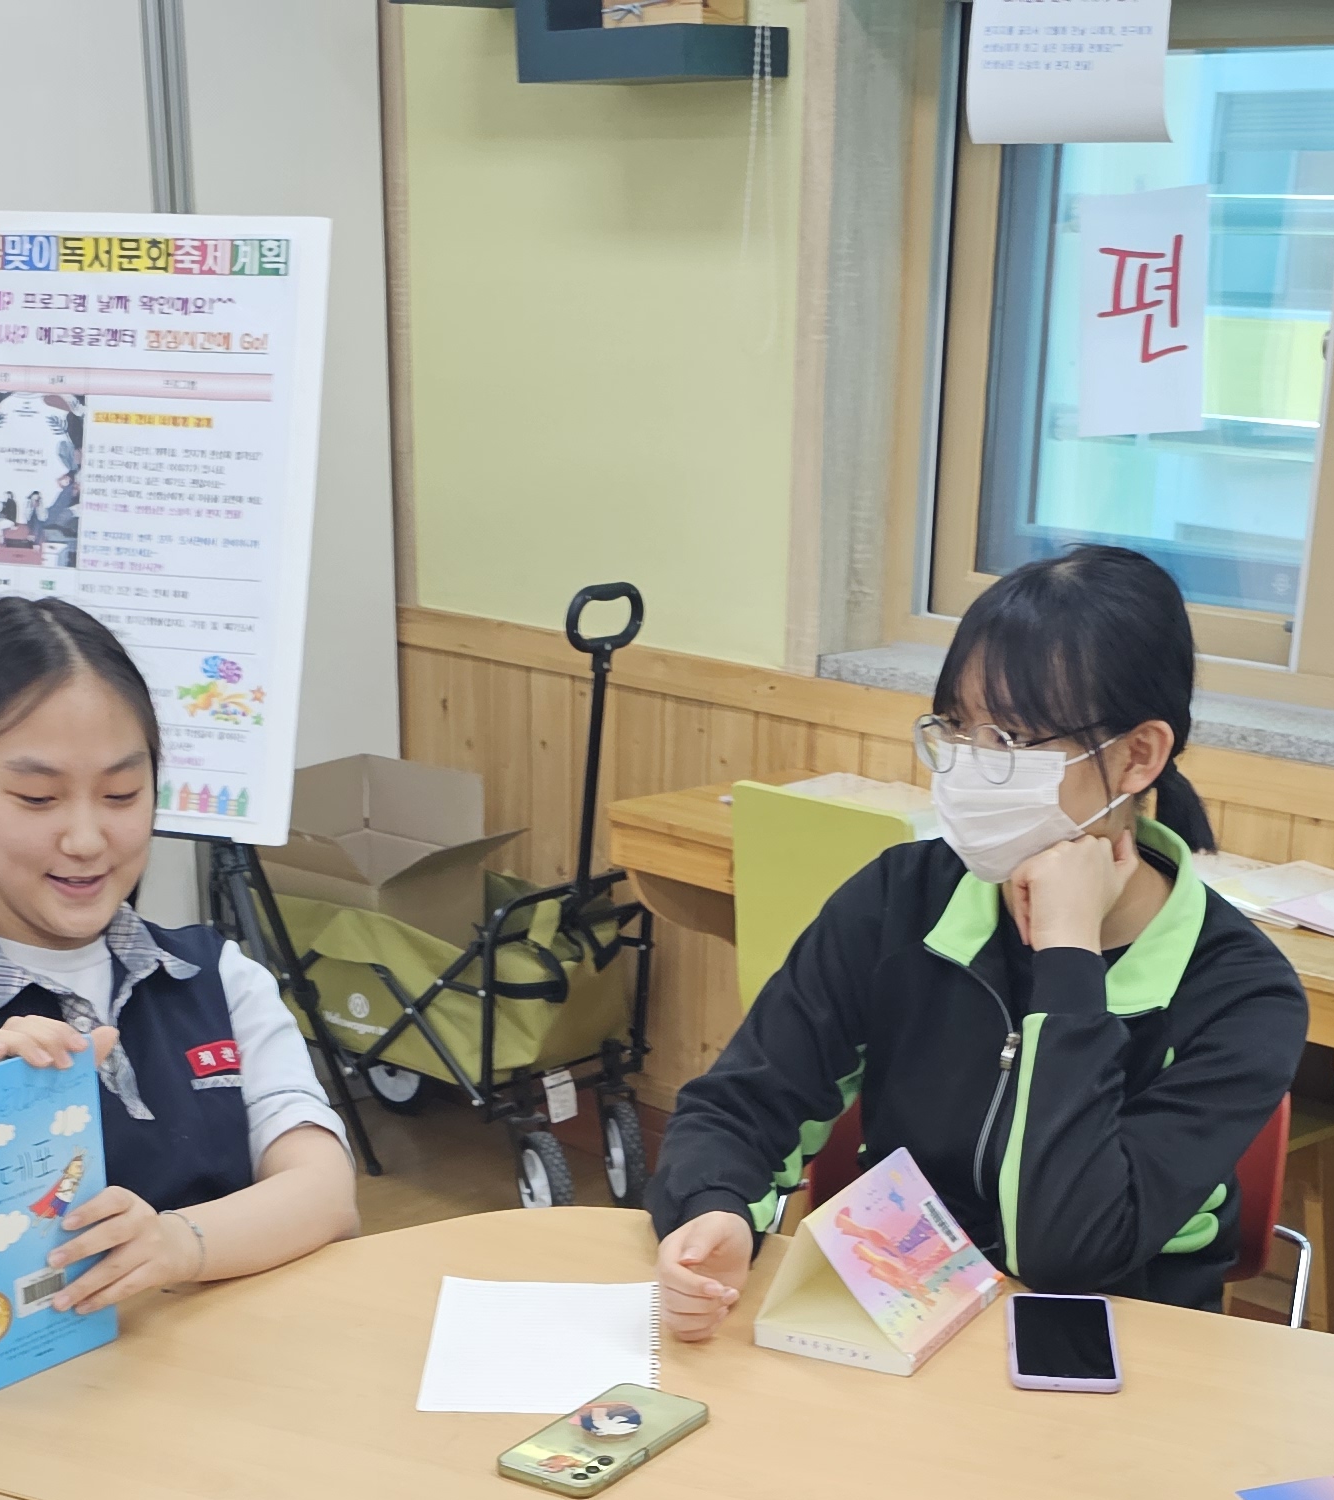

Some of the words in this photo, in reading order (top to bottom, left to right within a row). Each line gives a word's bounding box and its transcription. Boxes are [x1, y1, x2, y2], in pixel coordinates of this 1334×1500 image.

[21, 292, 88, 313] 프로그램
[96, 294, 130, 314] 날짜
[1098, 234, 1189, 363] 편
